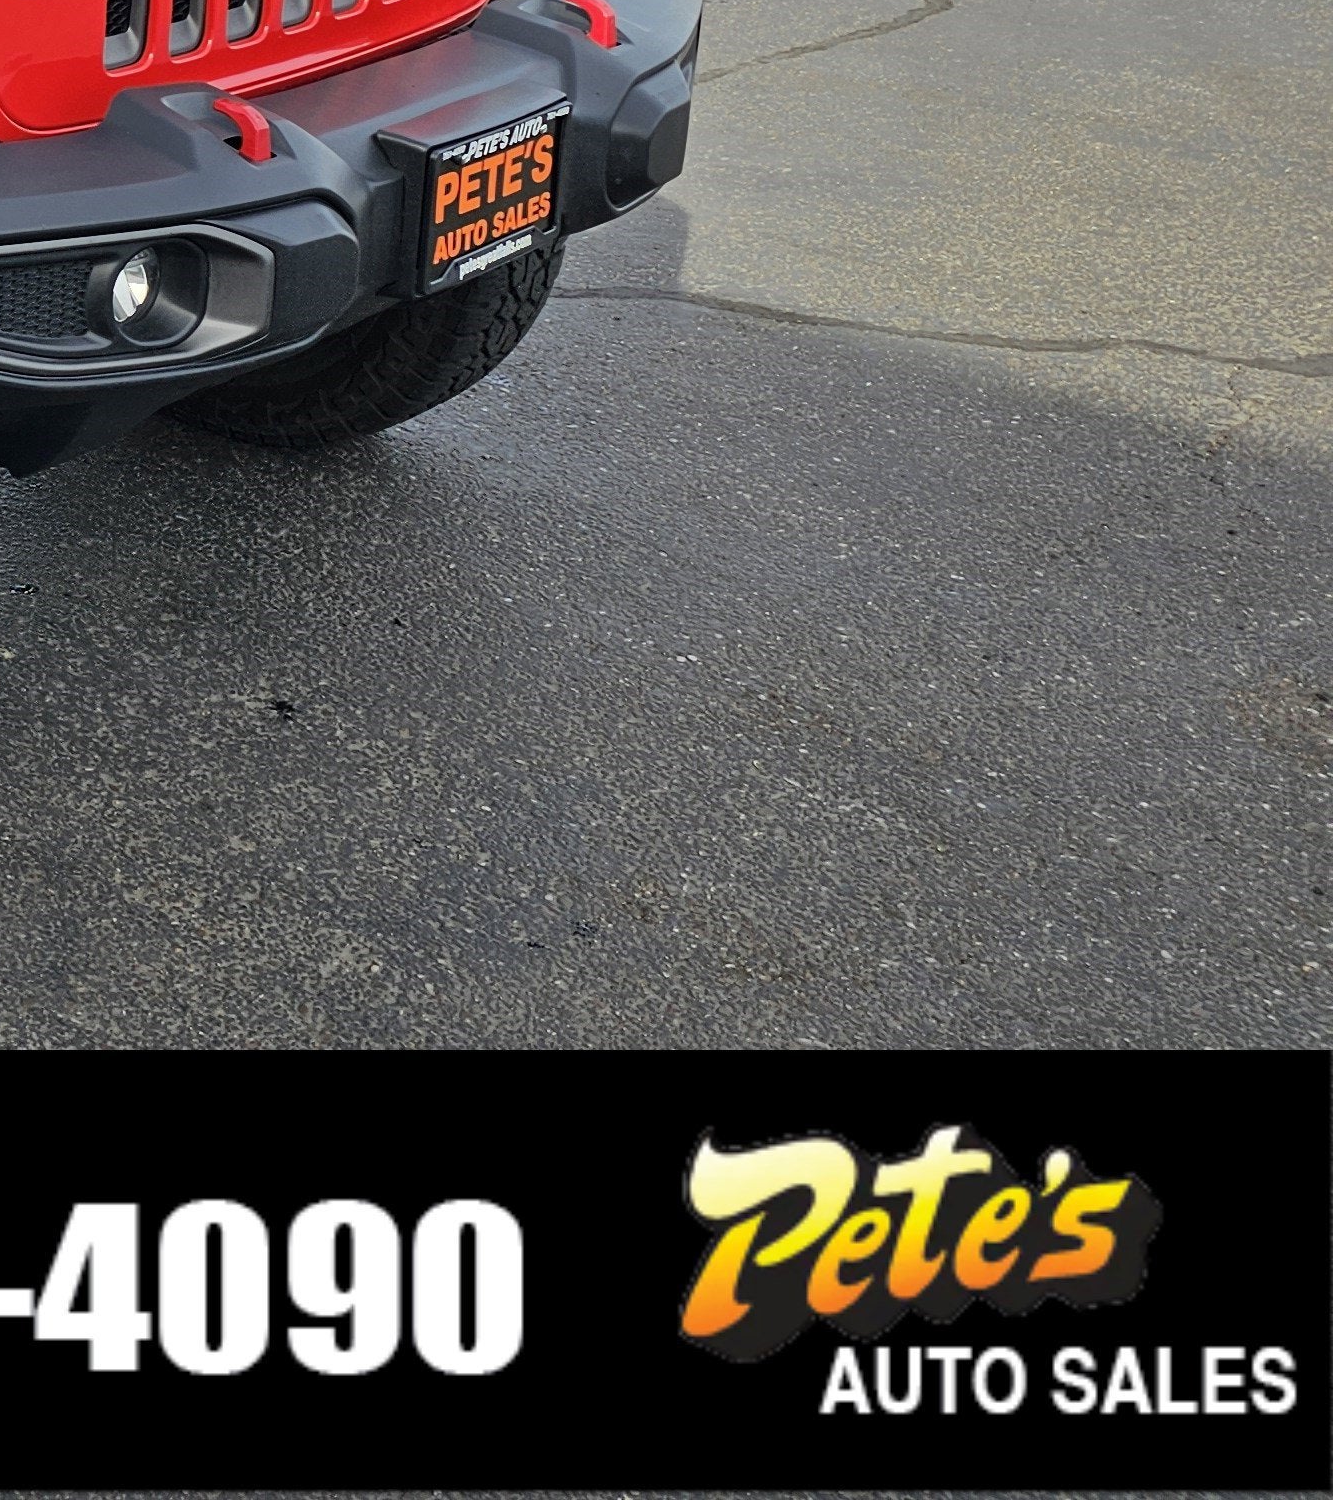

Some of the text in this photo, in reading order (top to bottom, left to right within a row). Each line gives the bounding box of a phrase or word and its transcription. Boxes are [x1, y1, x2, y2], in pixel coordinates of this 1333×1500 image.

[510, 115, 543, 146] AUTO
[435, 134, 554, 224] PETE'S
[433, 191, 551, 265] AUTO SALES
